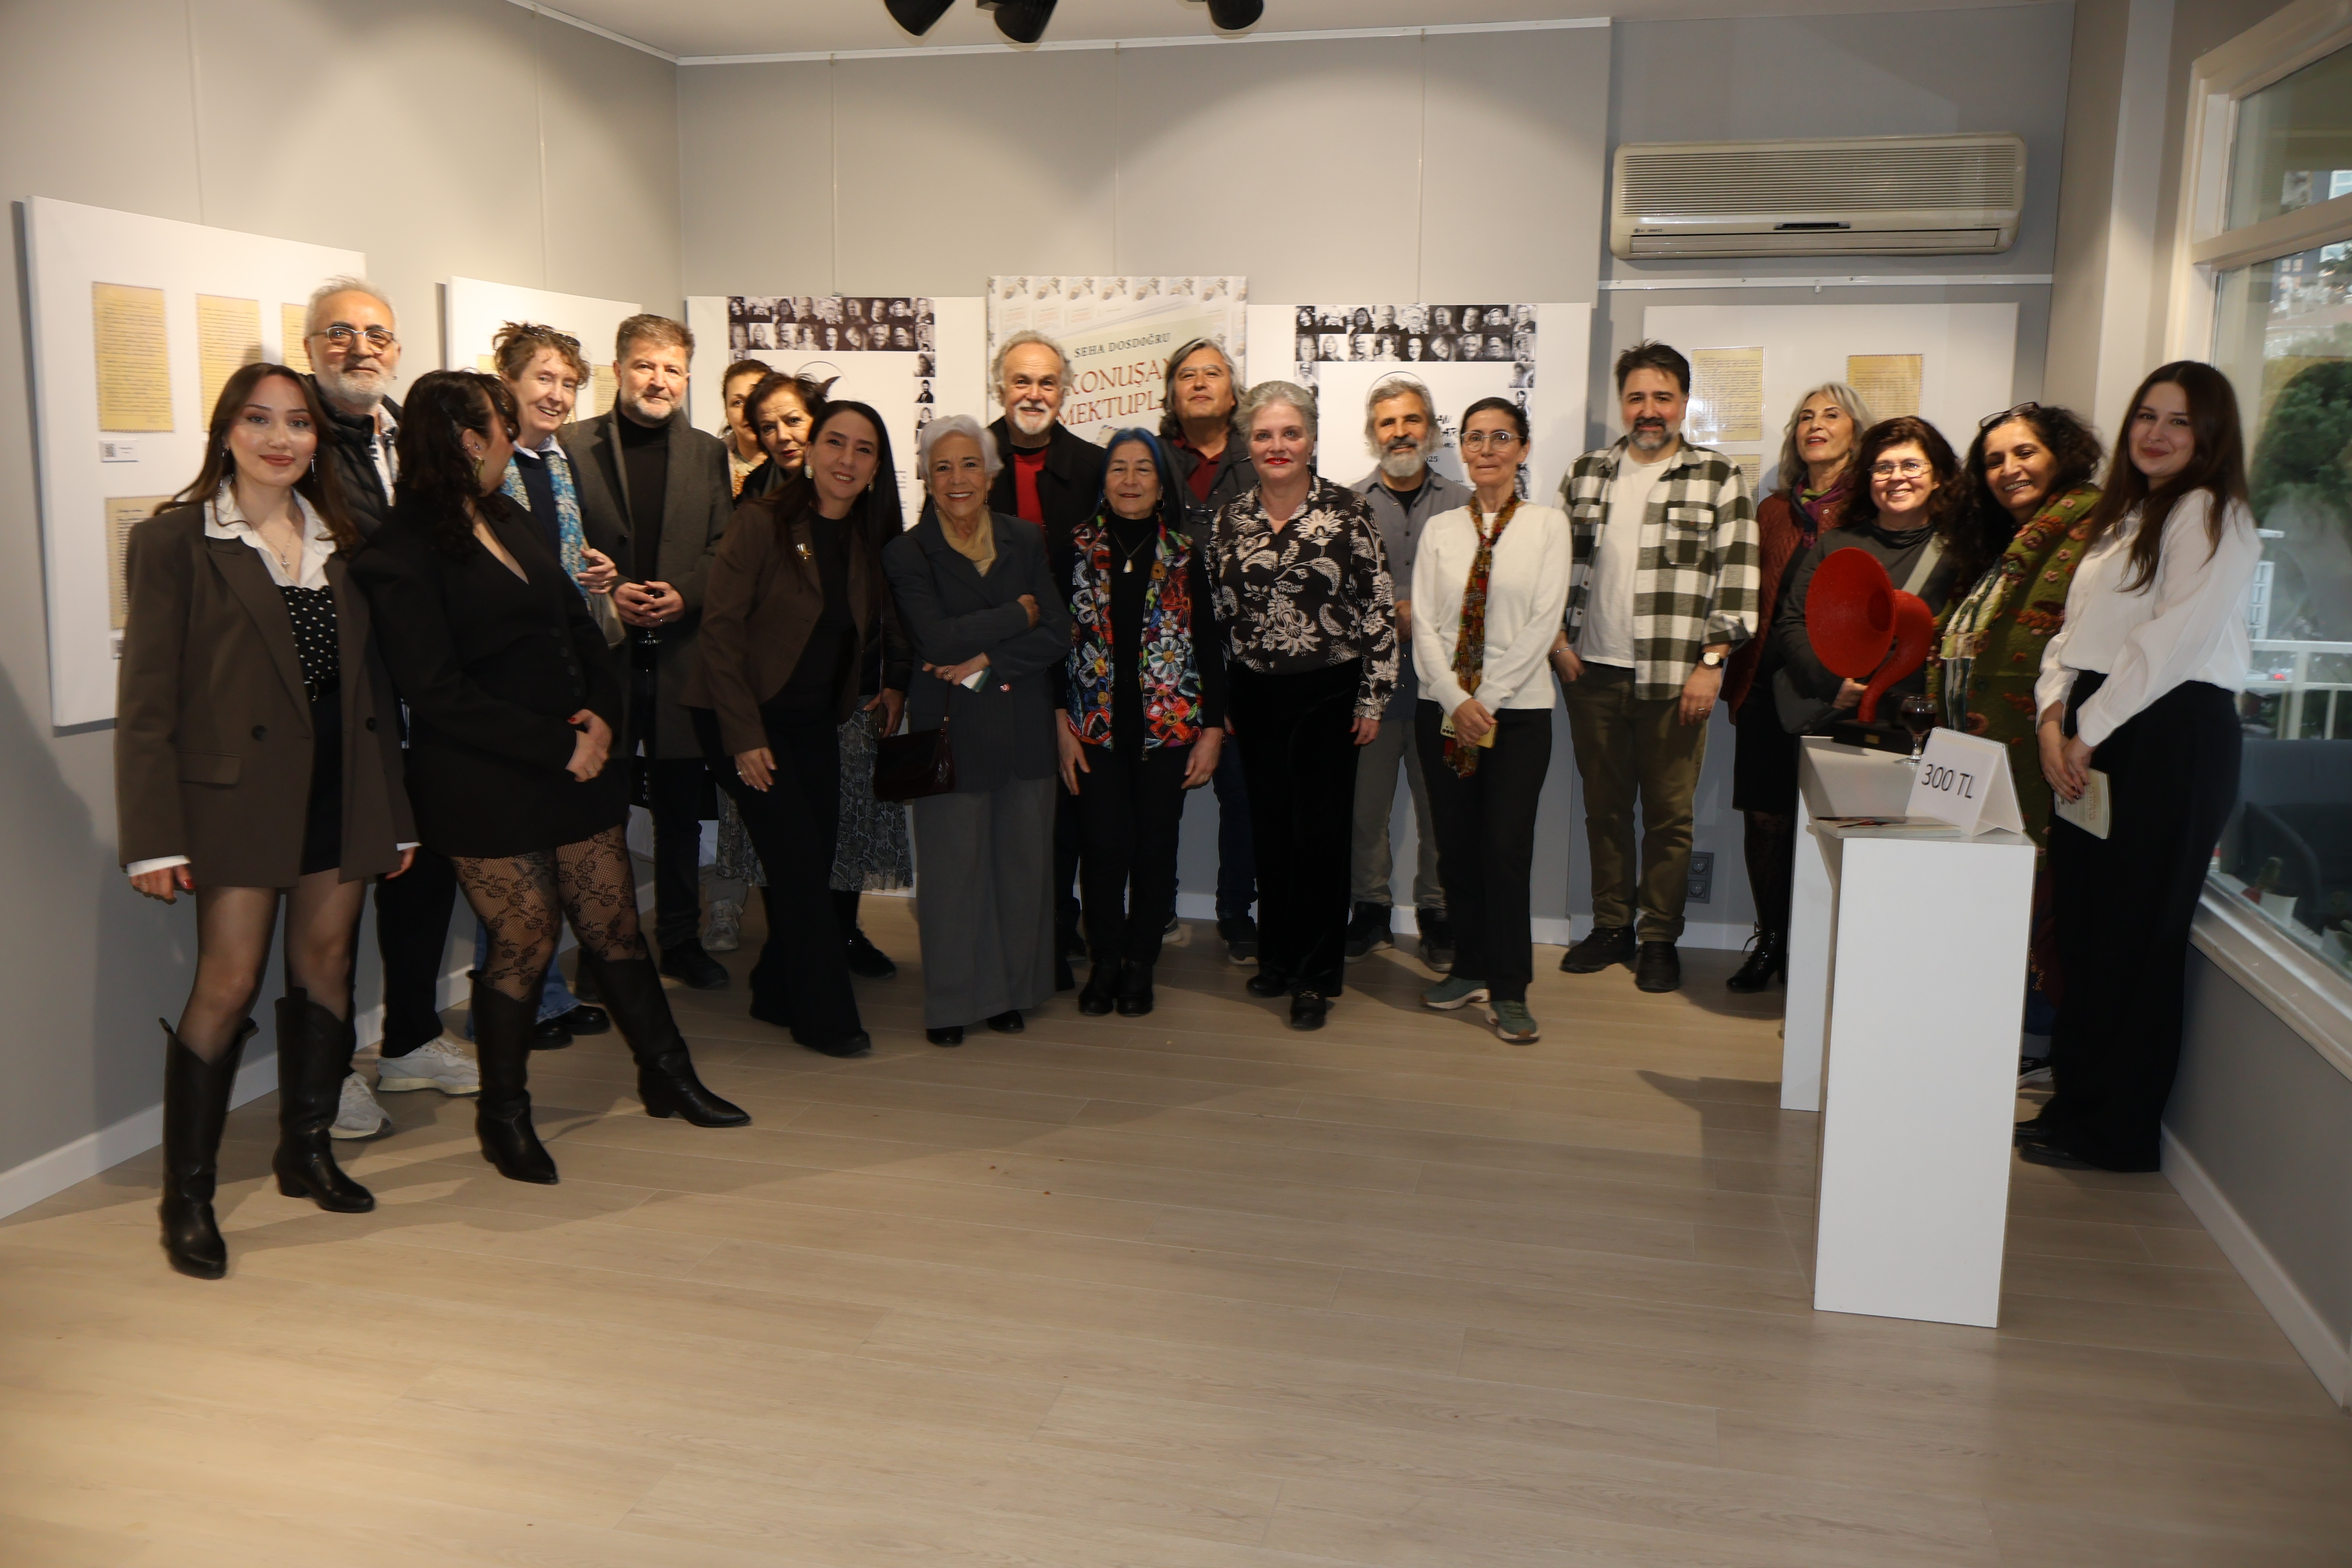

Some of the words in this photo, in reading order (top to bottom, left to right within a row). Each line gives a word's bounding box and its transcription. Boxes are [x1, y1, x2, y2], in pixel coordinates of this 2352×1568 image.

[1074, 344, 1105, 358] SEHA
[1108, 333, 1171, 352] DOSDOĞRU
[1058, 390, 1164, 425] MEKTUPL
[1921, 764, 1954, 791] 300
[1957, 773, 1973, 799] TL
